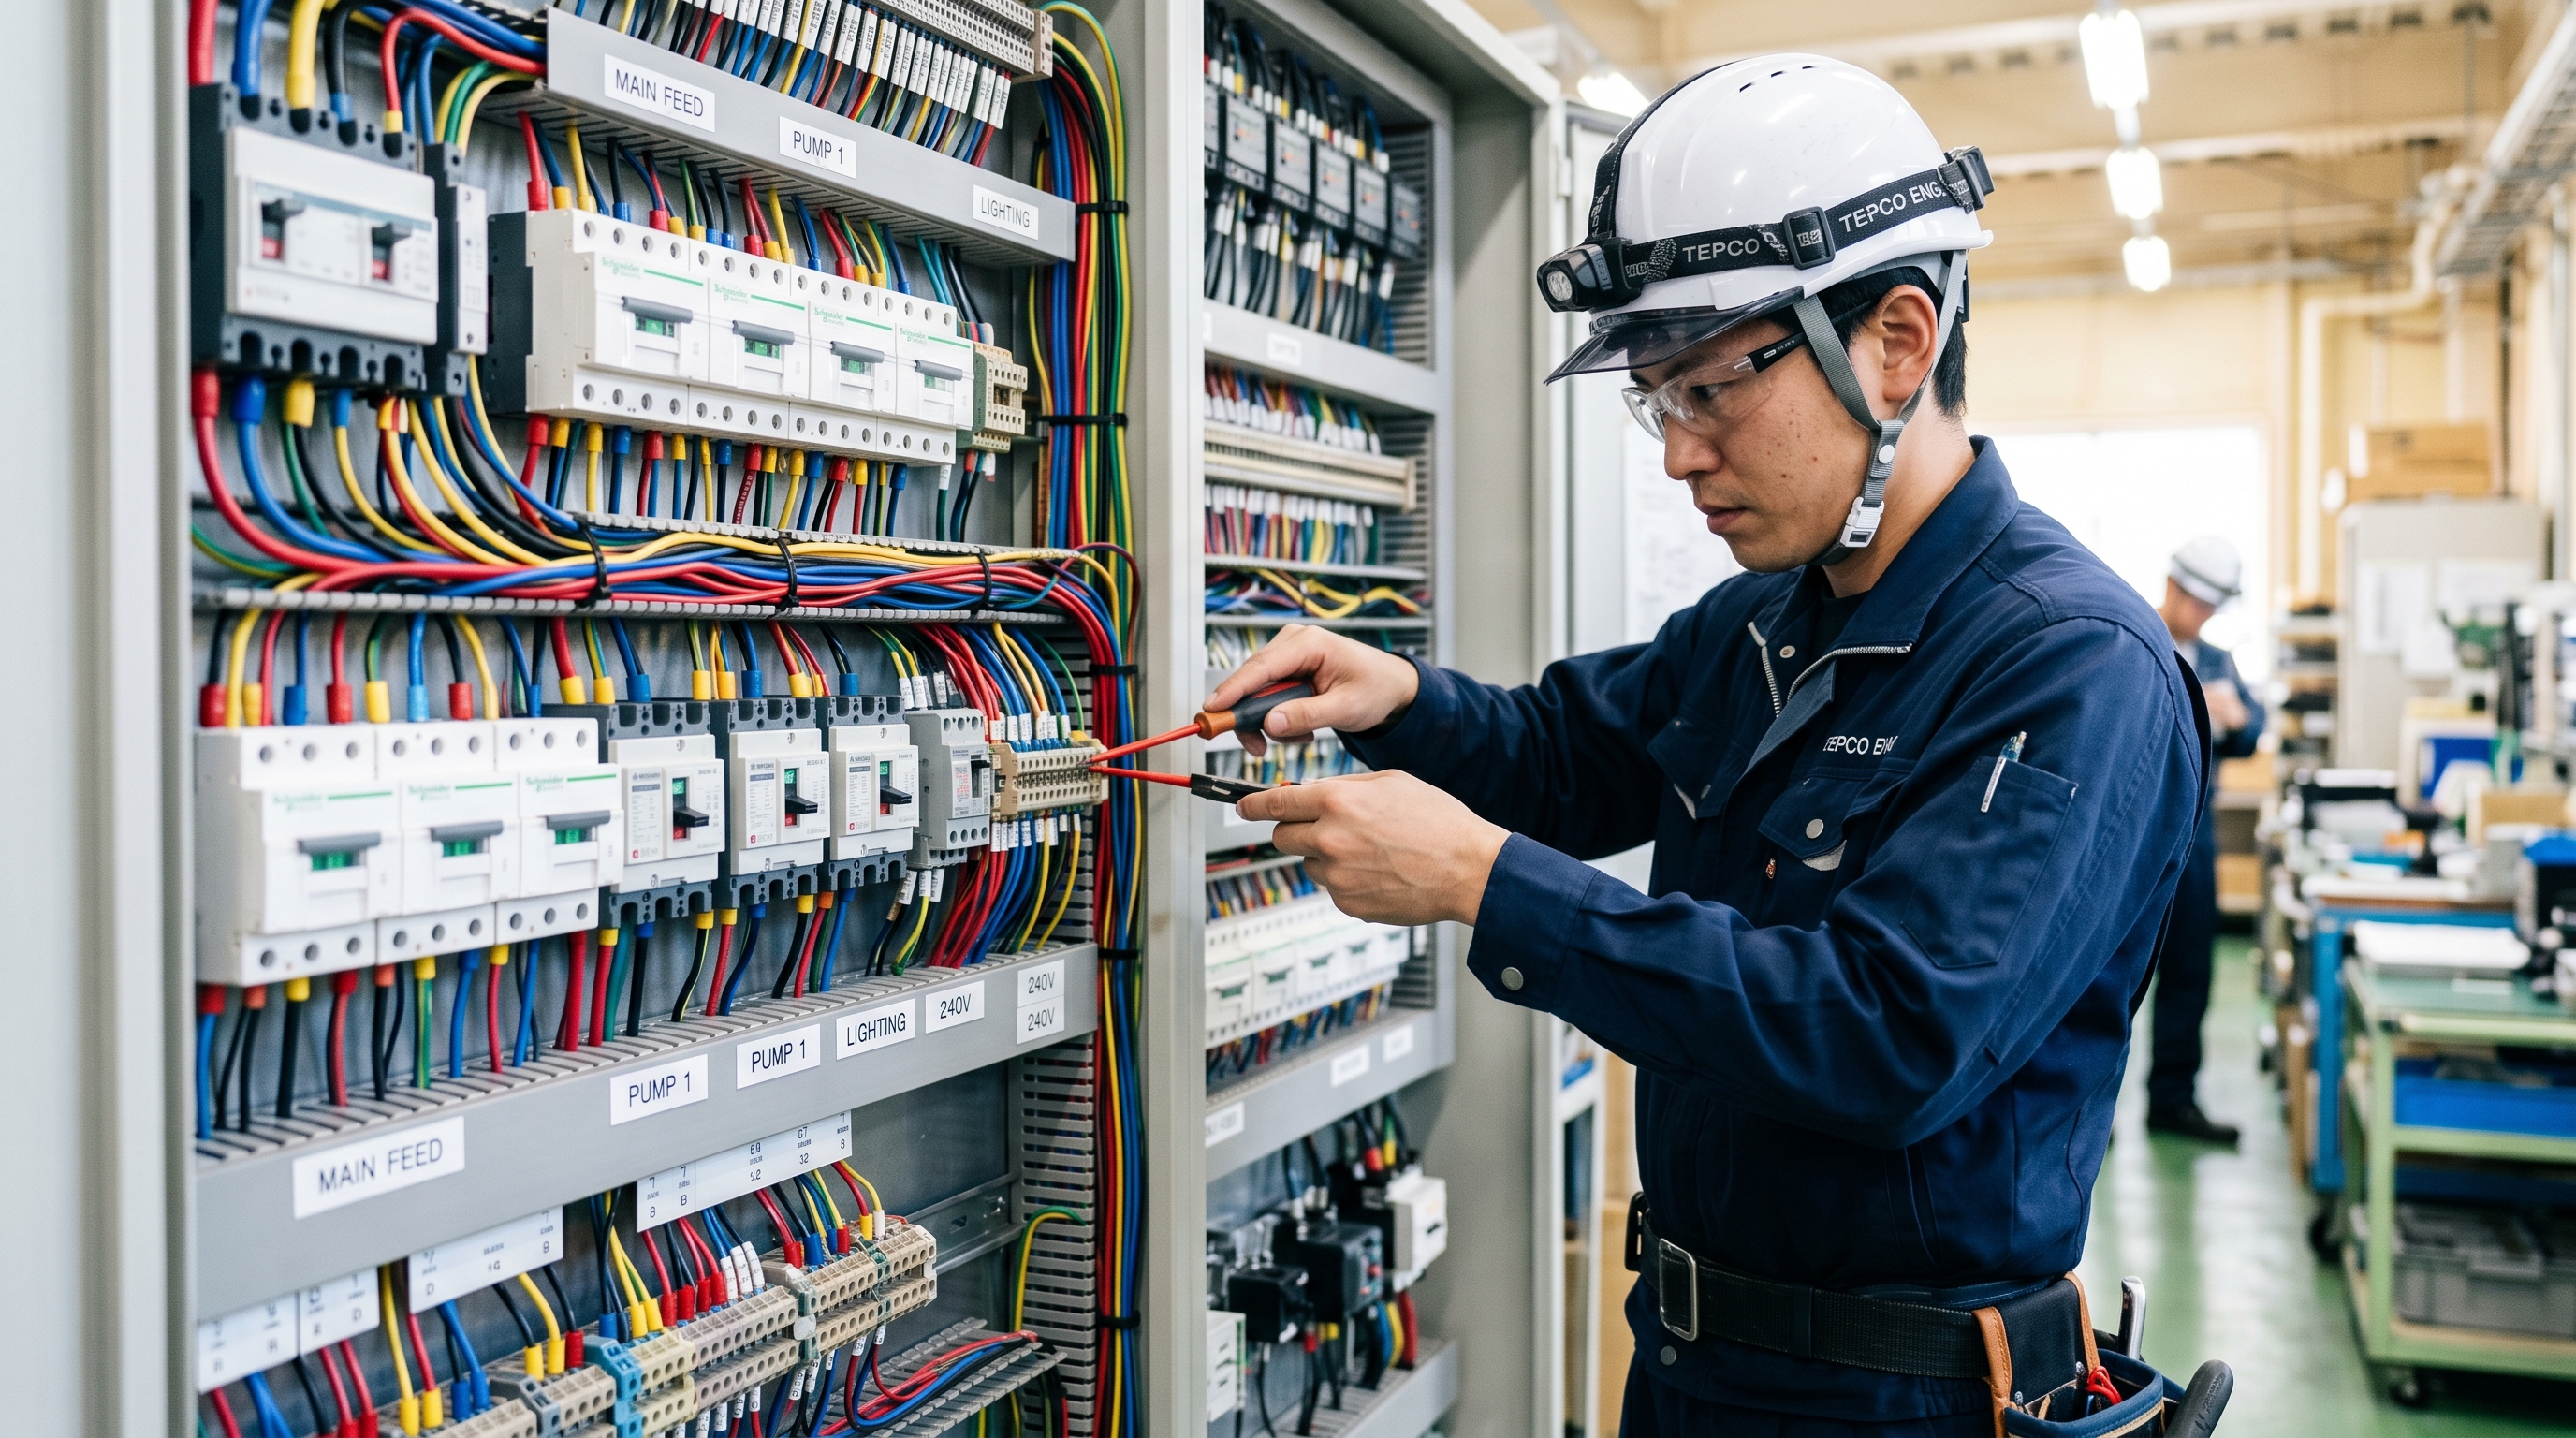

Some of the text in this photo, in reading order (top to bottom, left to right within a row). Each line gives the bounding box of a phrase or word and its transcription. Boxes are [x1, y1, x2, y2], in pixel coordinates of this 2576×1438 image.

[616, 68, 704, 117] MAIN FEED
[794, 130, 843, 165] PUMP 1
[981, 197, 1030, 228] LIGHTING
[1838, 193, 1907, 233] TEPCO
[1682, 238, 1760, 263] TEPCO
[1028, 972, 1055, 993] 240V
[940, 994, 972, 1020] 240V
[1028, 1007, 1055, 1031] 240V
[847, 1011, 906, 1047] LIGHTING
[752, 1039, 806, 1073] PUMP 1
[629, 1071, 691, 1108] PUMP 1
[319, 1138, 443, 1192] MAIN FEED
